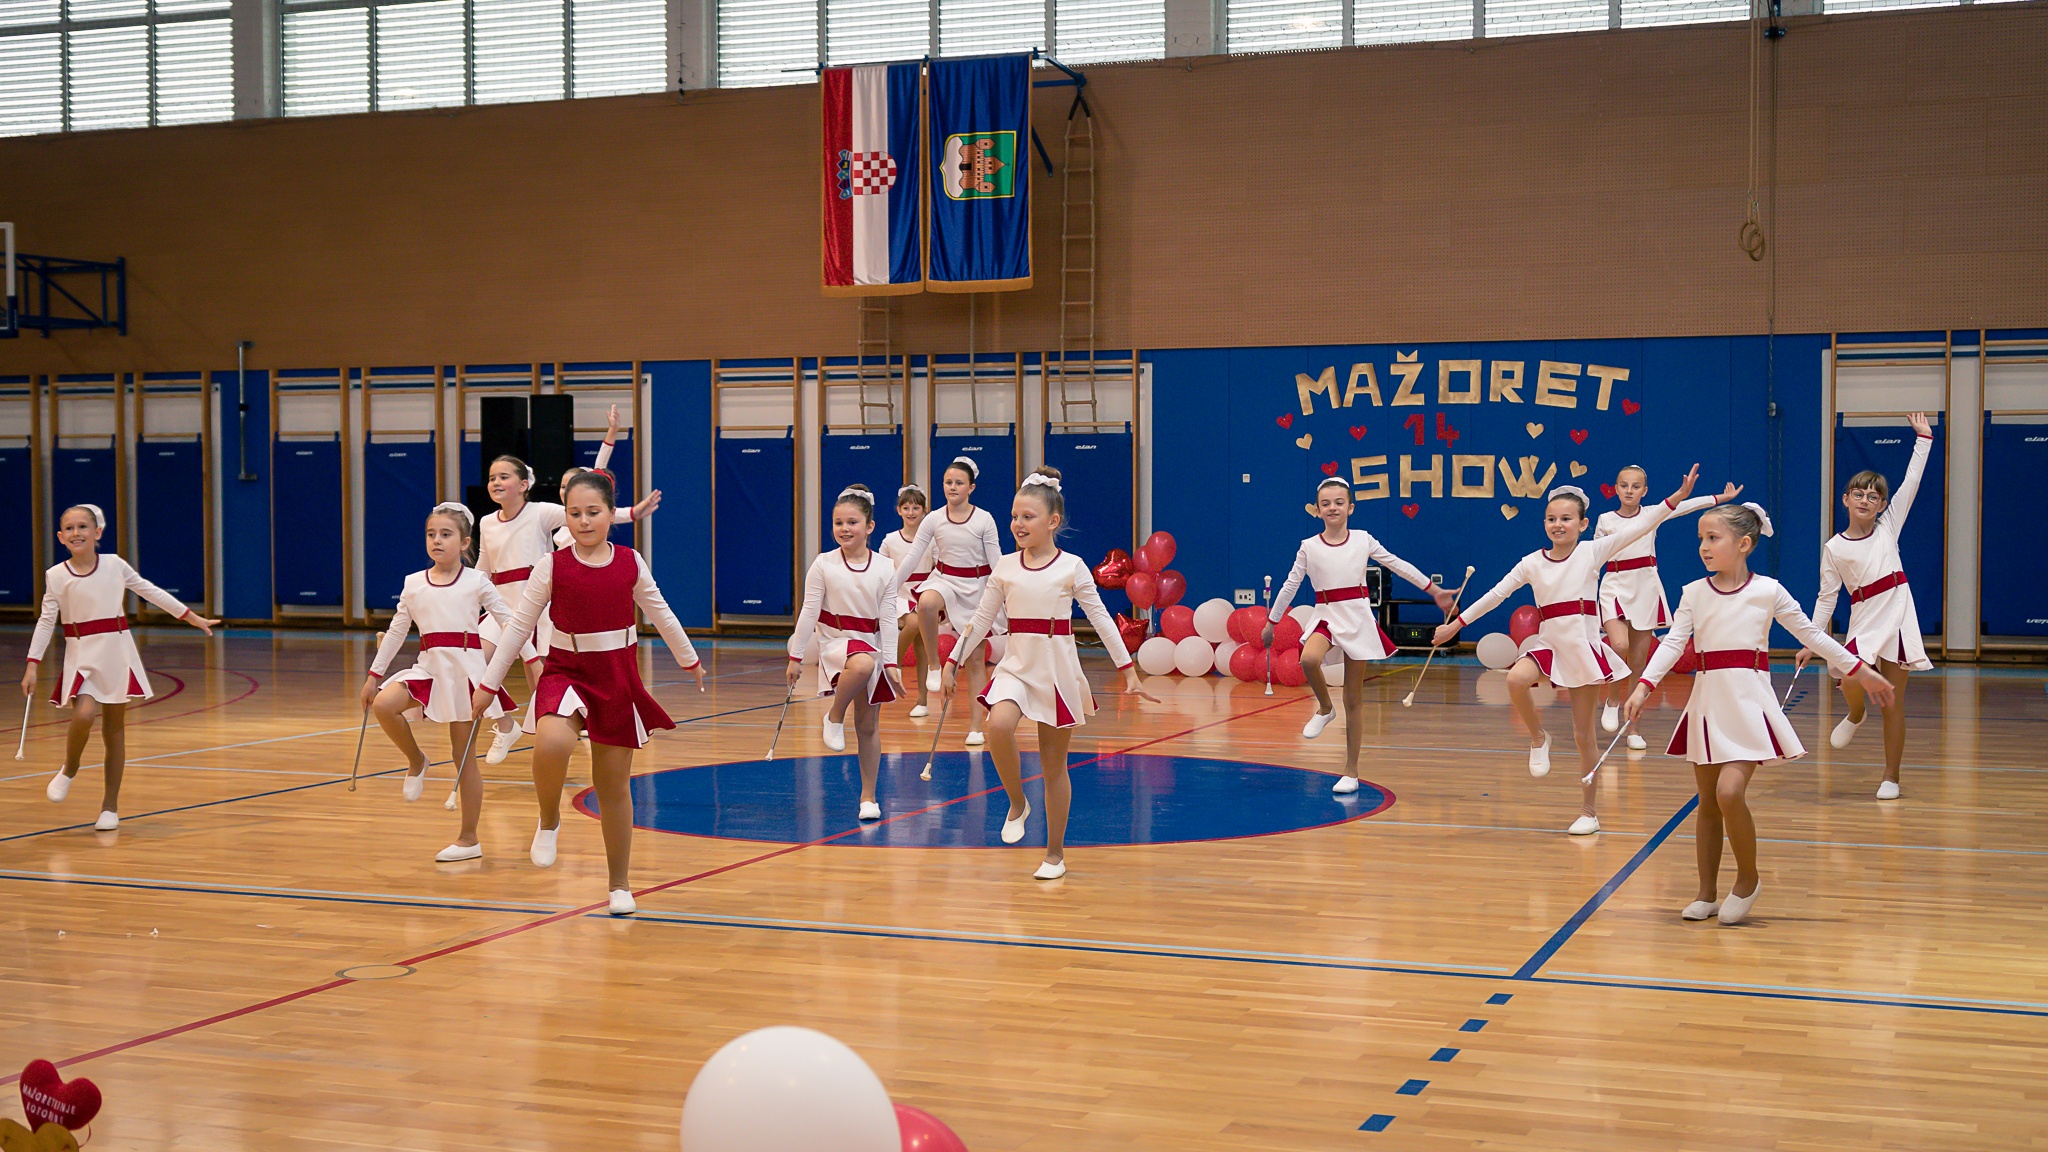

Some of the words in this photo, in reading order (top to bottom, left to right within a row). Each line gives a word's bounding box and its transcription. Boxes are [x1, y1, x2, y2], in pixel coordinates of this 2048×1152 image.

[1295, 350, 1630, 415] MAŽORET
[1403, 412, 1460, 448] 14
[1351, 455, 1557, 501] SHOW
